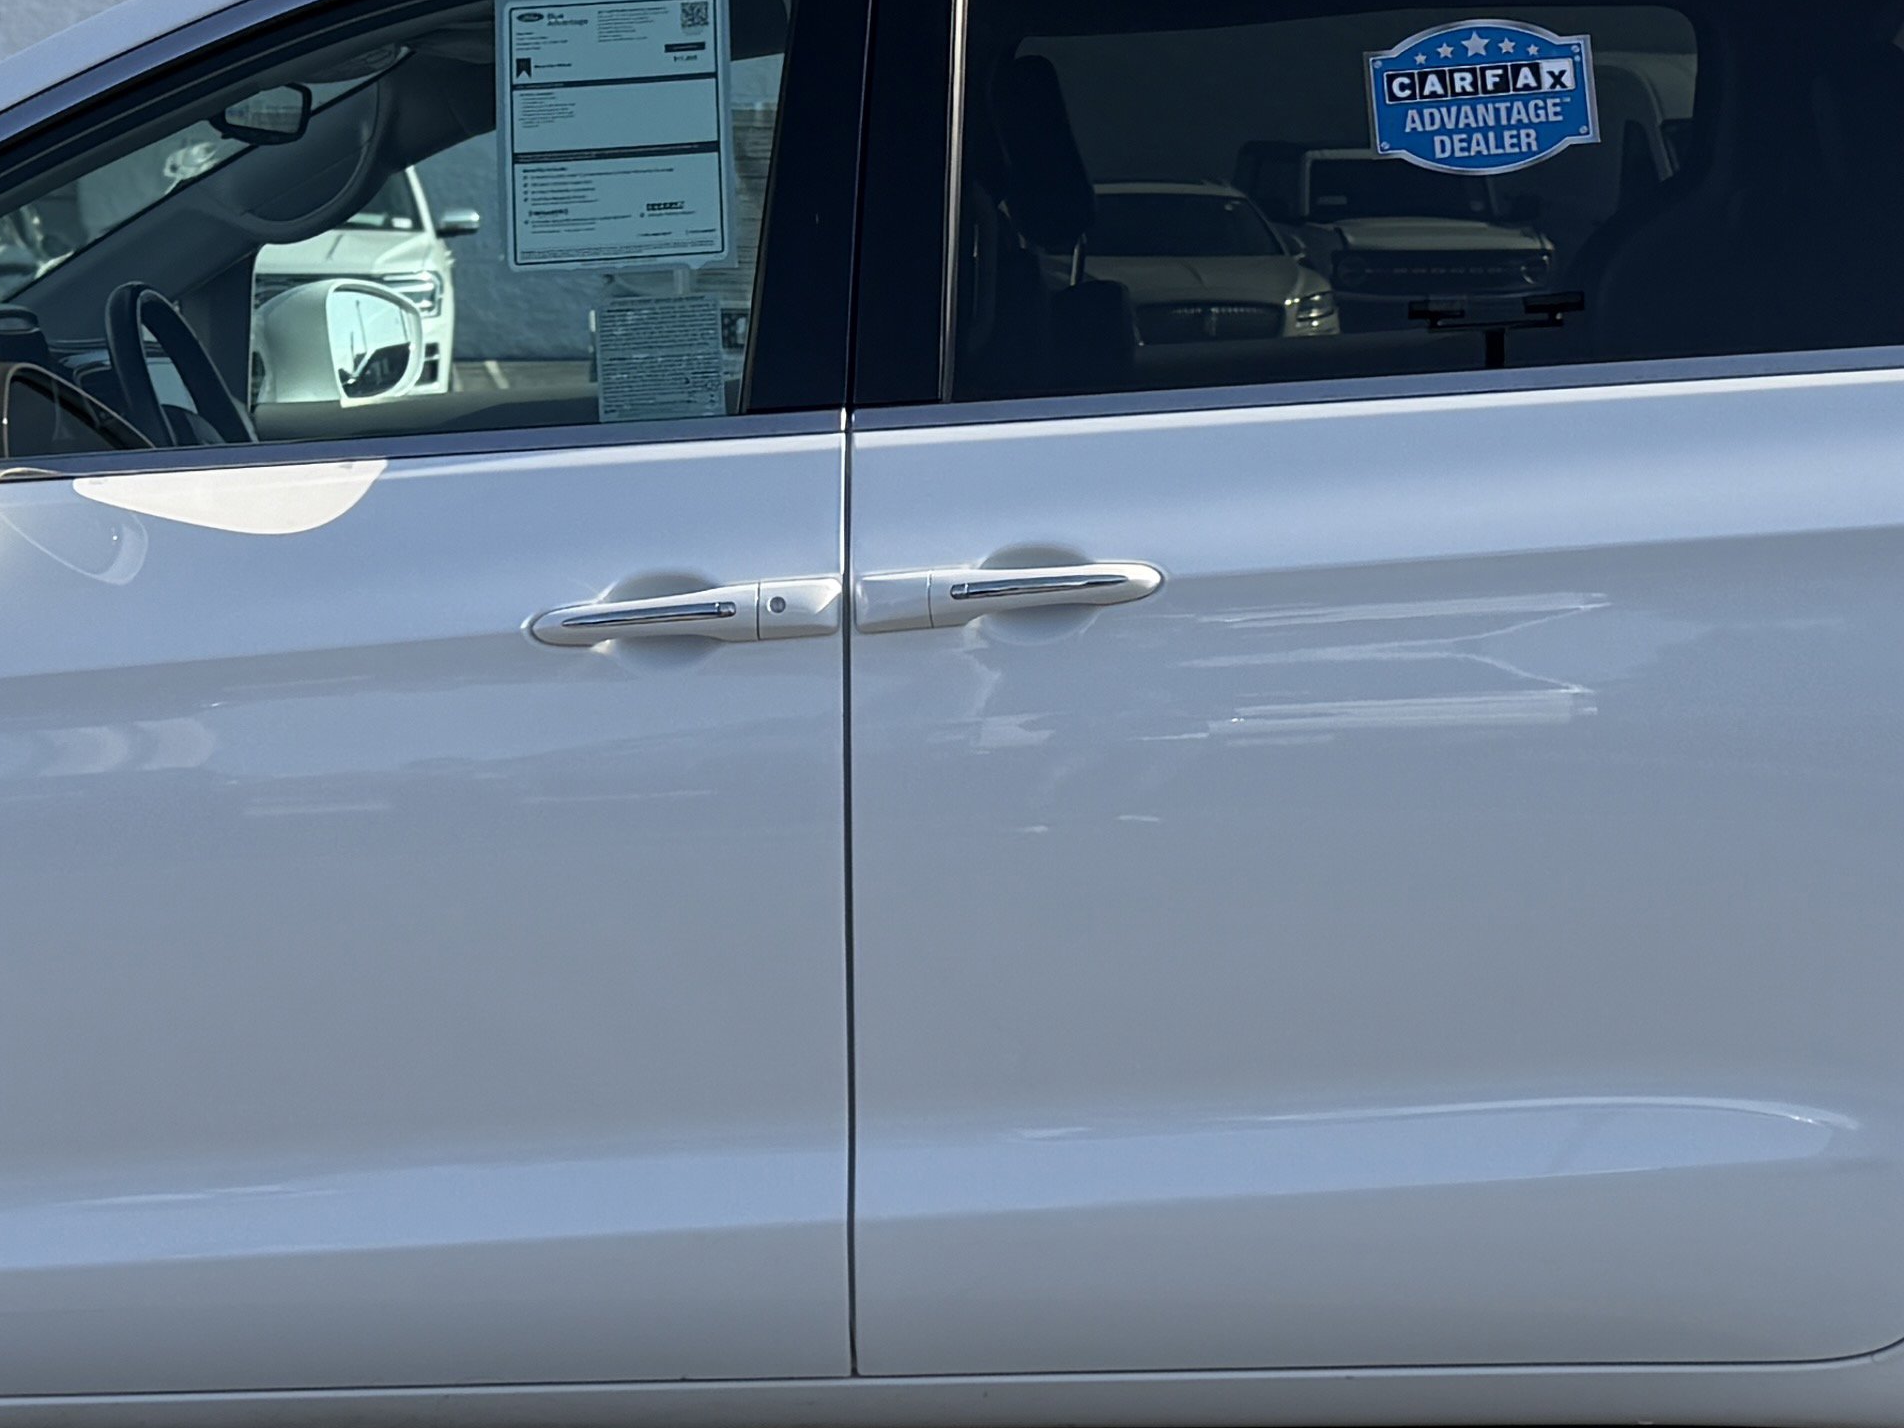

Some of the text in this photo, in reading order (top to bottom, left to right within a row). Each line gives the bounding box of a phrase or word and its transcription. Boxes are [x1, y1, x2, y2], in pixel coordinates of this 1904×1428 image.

[1391, 66, 1568, 99] CARFAX
[1405, 98, 1564, 132] ADVANTAGE
[1434, 129, 1538, 159] DEALER
